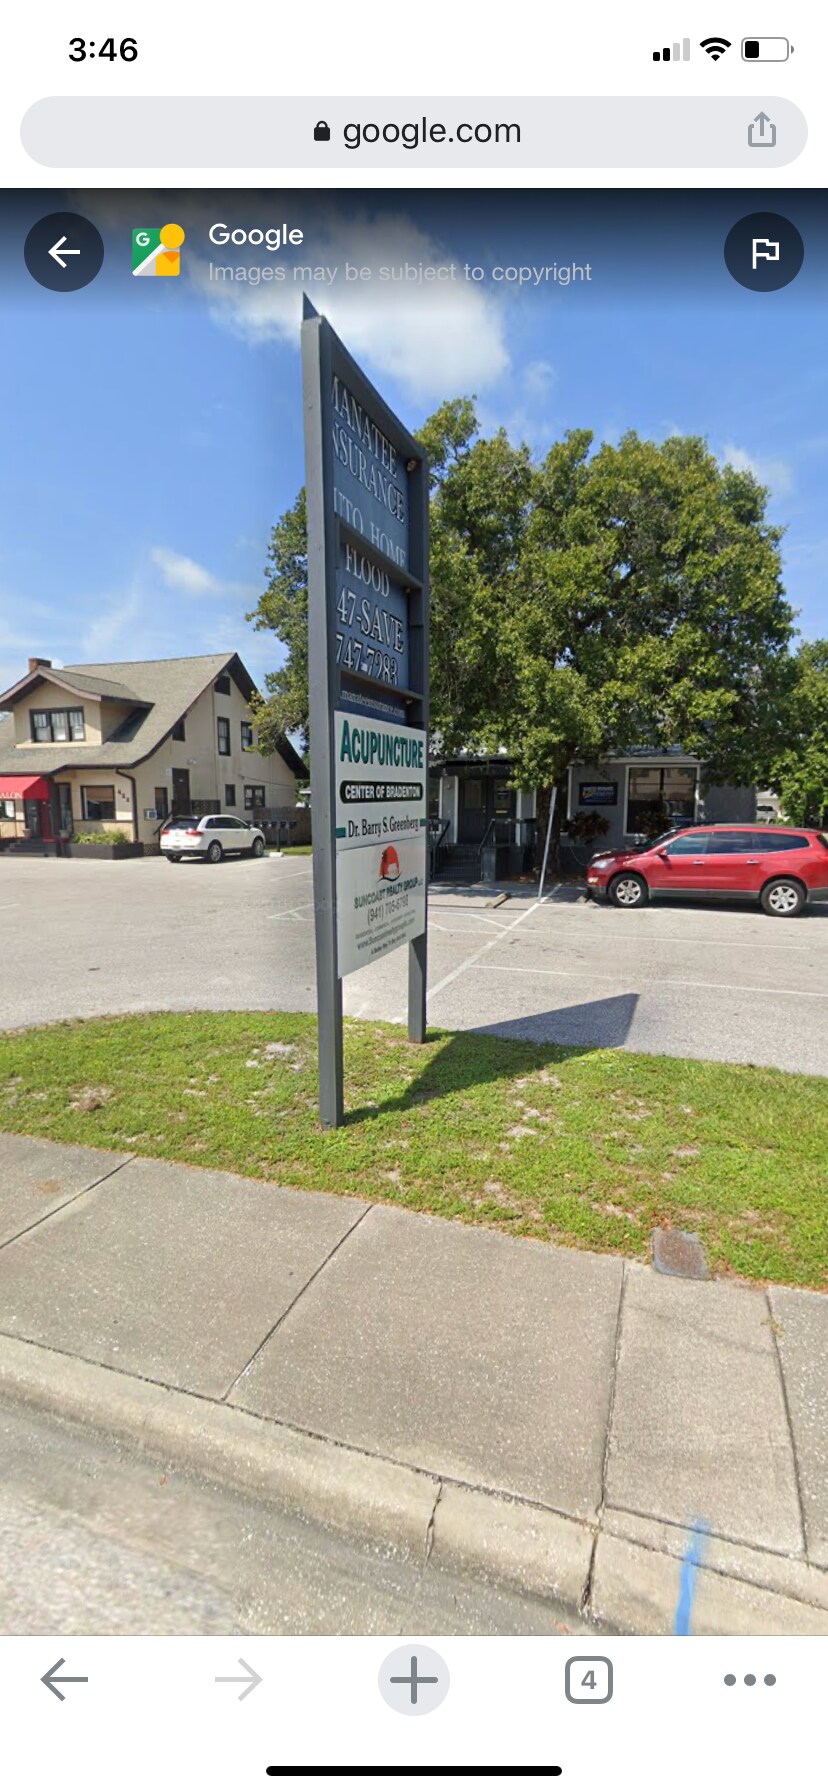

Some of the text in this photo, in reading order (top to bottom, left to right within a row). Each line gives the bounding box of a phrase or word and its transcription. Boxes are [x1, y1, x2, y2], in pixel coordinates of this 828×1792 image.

[345, 543, 390, 597] FLOOD
[337, 587, 404, 653] 47-SAVE
[345, 784, 420, 799] CENTER OF BRADENTON
[348, 814, 419, 838] Dr. Barry S. Greenberg
[354, 888, 386, 909] SUNCOAST
[386, 880, 403, 898] REALTY
[403, 876, 418, 892] GROUP
[367, 904, 384, 926] (941)
